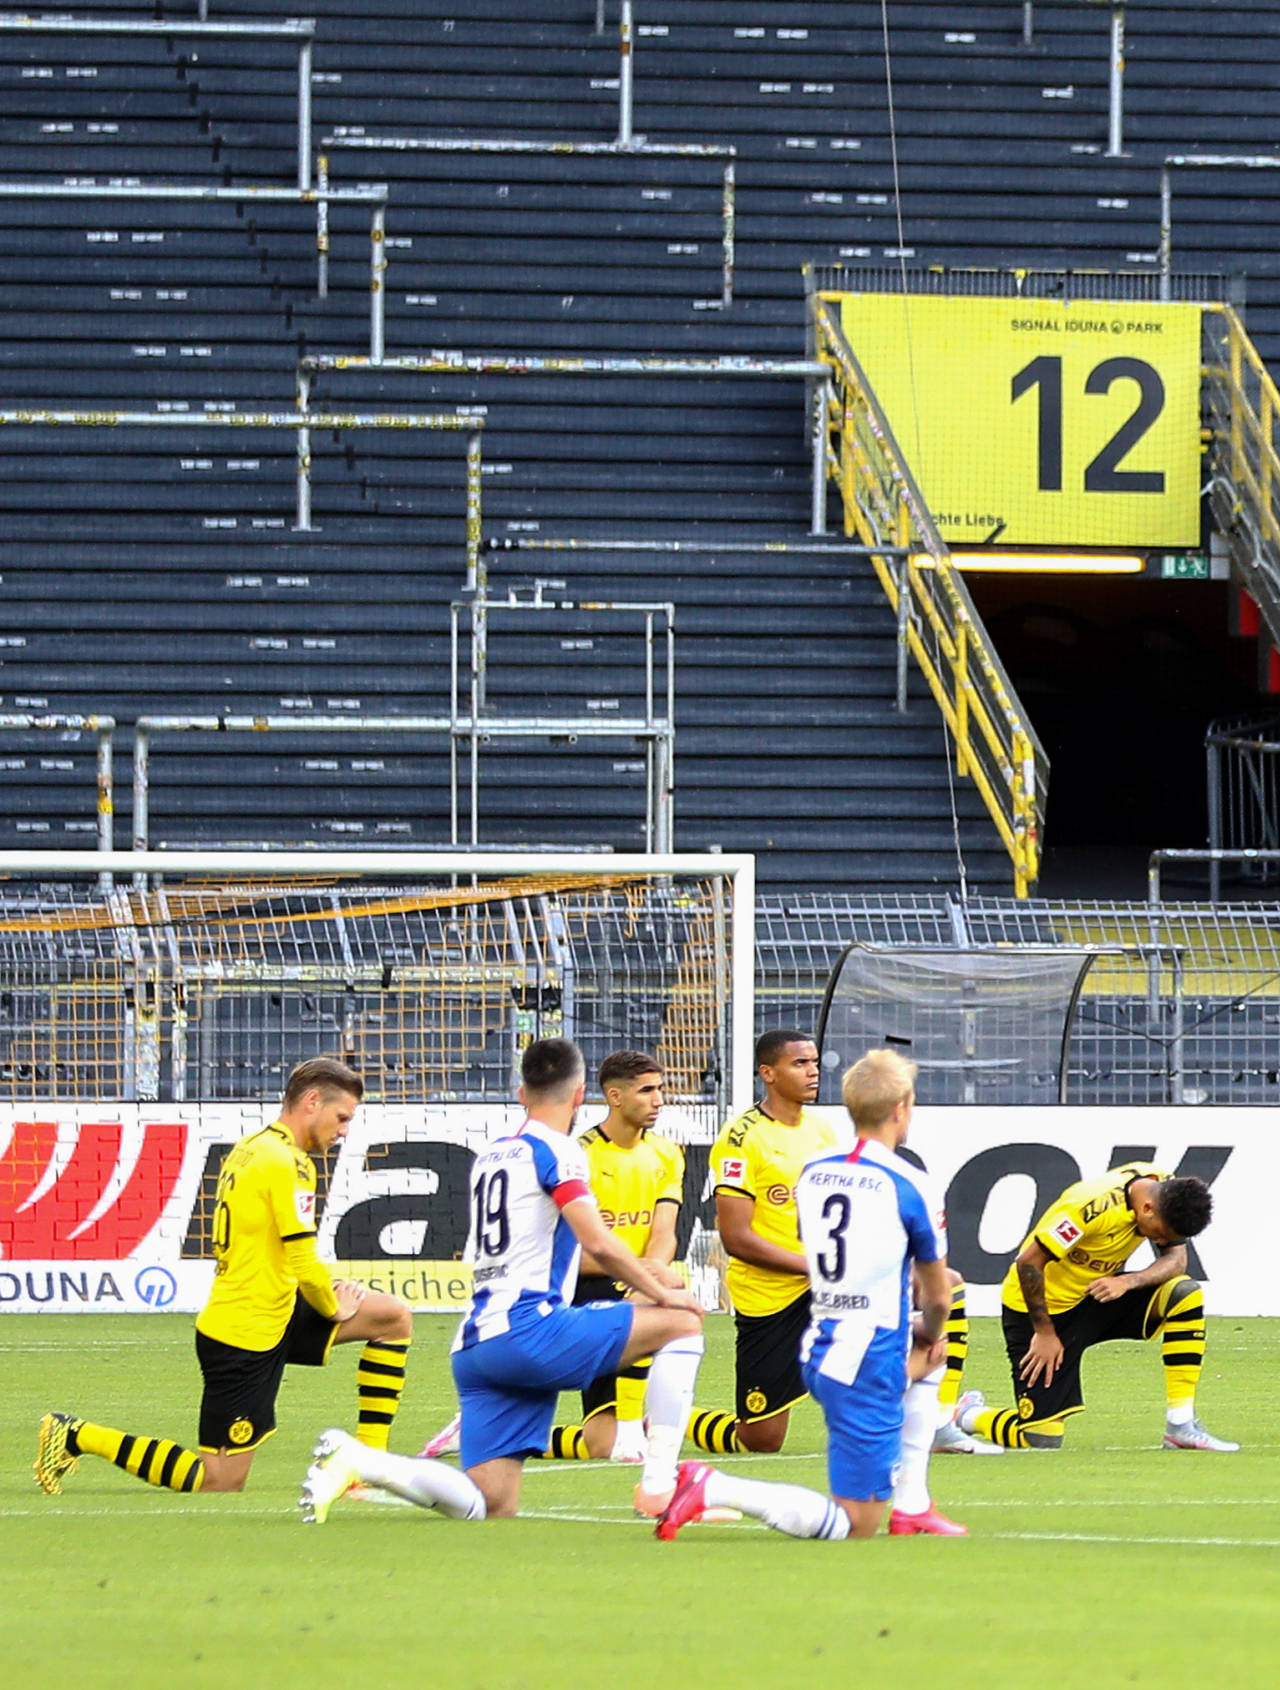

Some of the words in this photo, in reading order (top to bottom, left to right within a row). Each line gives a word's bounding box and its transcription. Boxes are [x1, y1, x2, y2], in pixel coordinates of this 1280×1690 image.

[1011, 319, 1060, 332] SIGNAL
[1064, 320, 1108, 333] IDUNA
[1126, 322, 1163, 334] PARK
[1011, 355, 1166, 493] 12
[933, 513, 961, 526] chte
[966, 513, 1004, 527] Liebe
[809, 1172, 853, 1187] HERTHA
[859, 1176, 883, 1193] BSC
[474, 1168, 510, 1258] 19
[817, 1193, 851, 1283] 3
